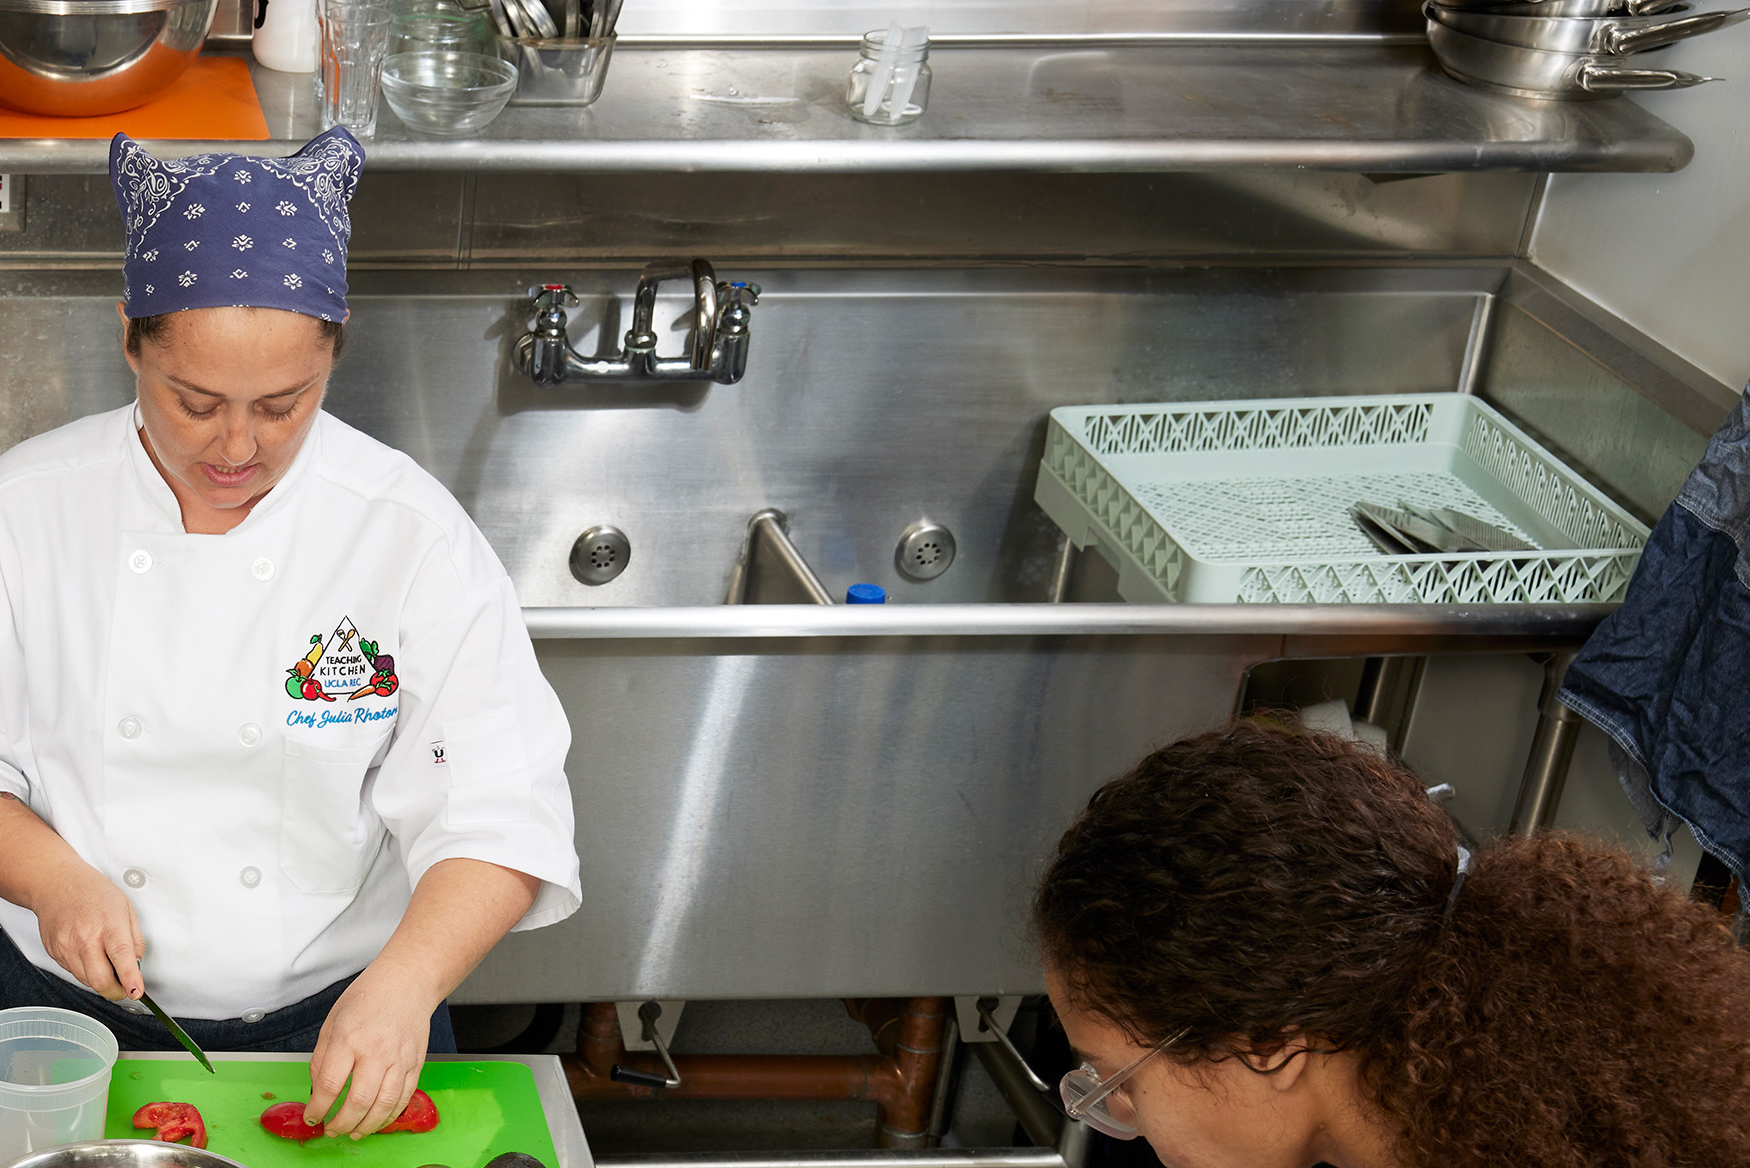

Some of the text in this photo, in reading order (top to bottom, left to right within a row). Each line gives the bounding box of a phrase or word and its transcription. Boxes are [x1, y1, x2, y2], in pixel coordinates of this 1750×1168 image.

[319, 664, 366, 677] KITCHEN
[324, 678, 361, 688] UCLA REC
[286, 709, 318, 727] Chef
[317, 710, 353, 728] Julia
